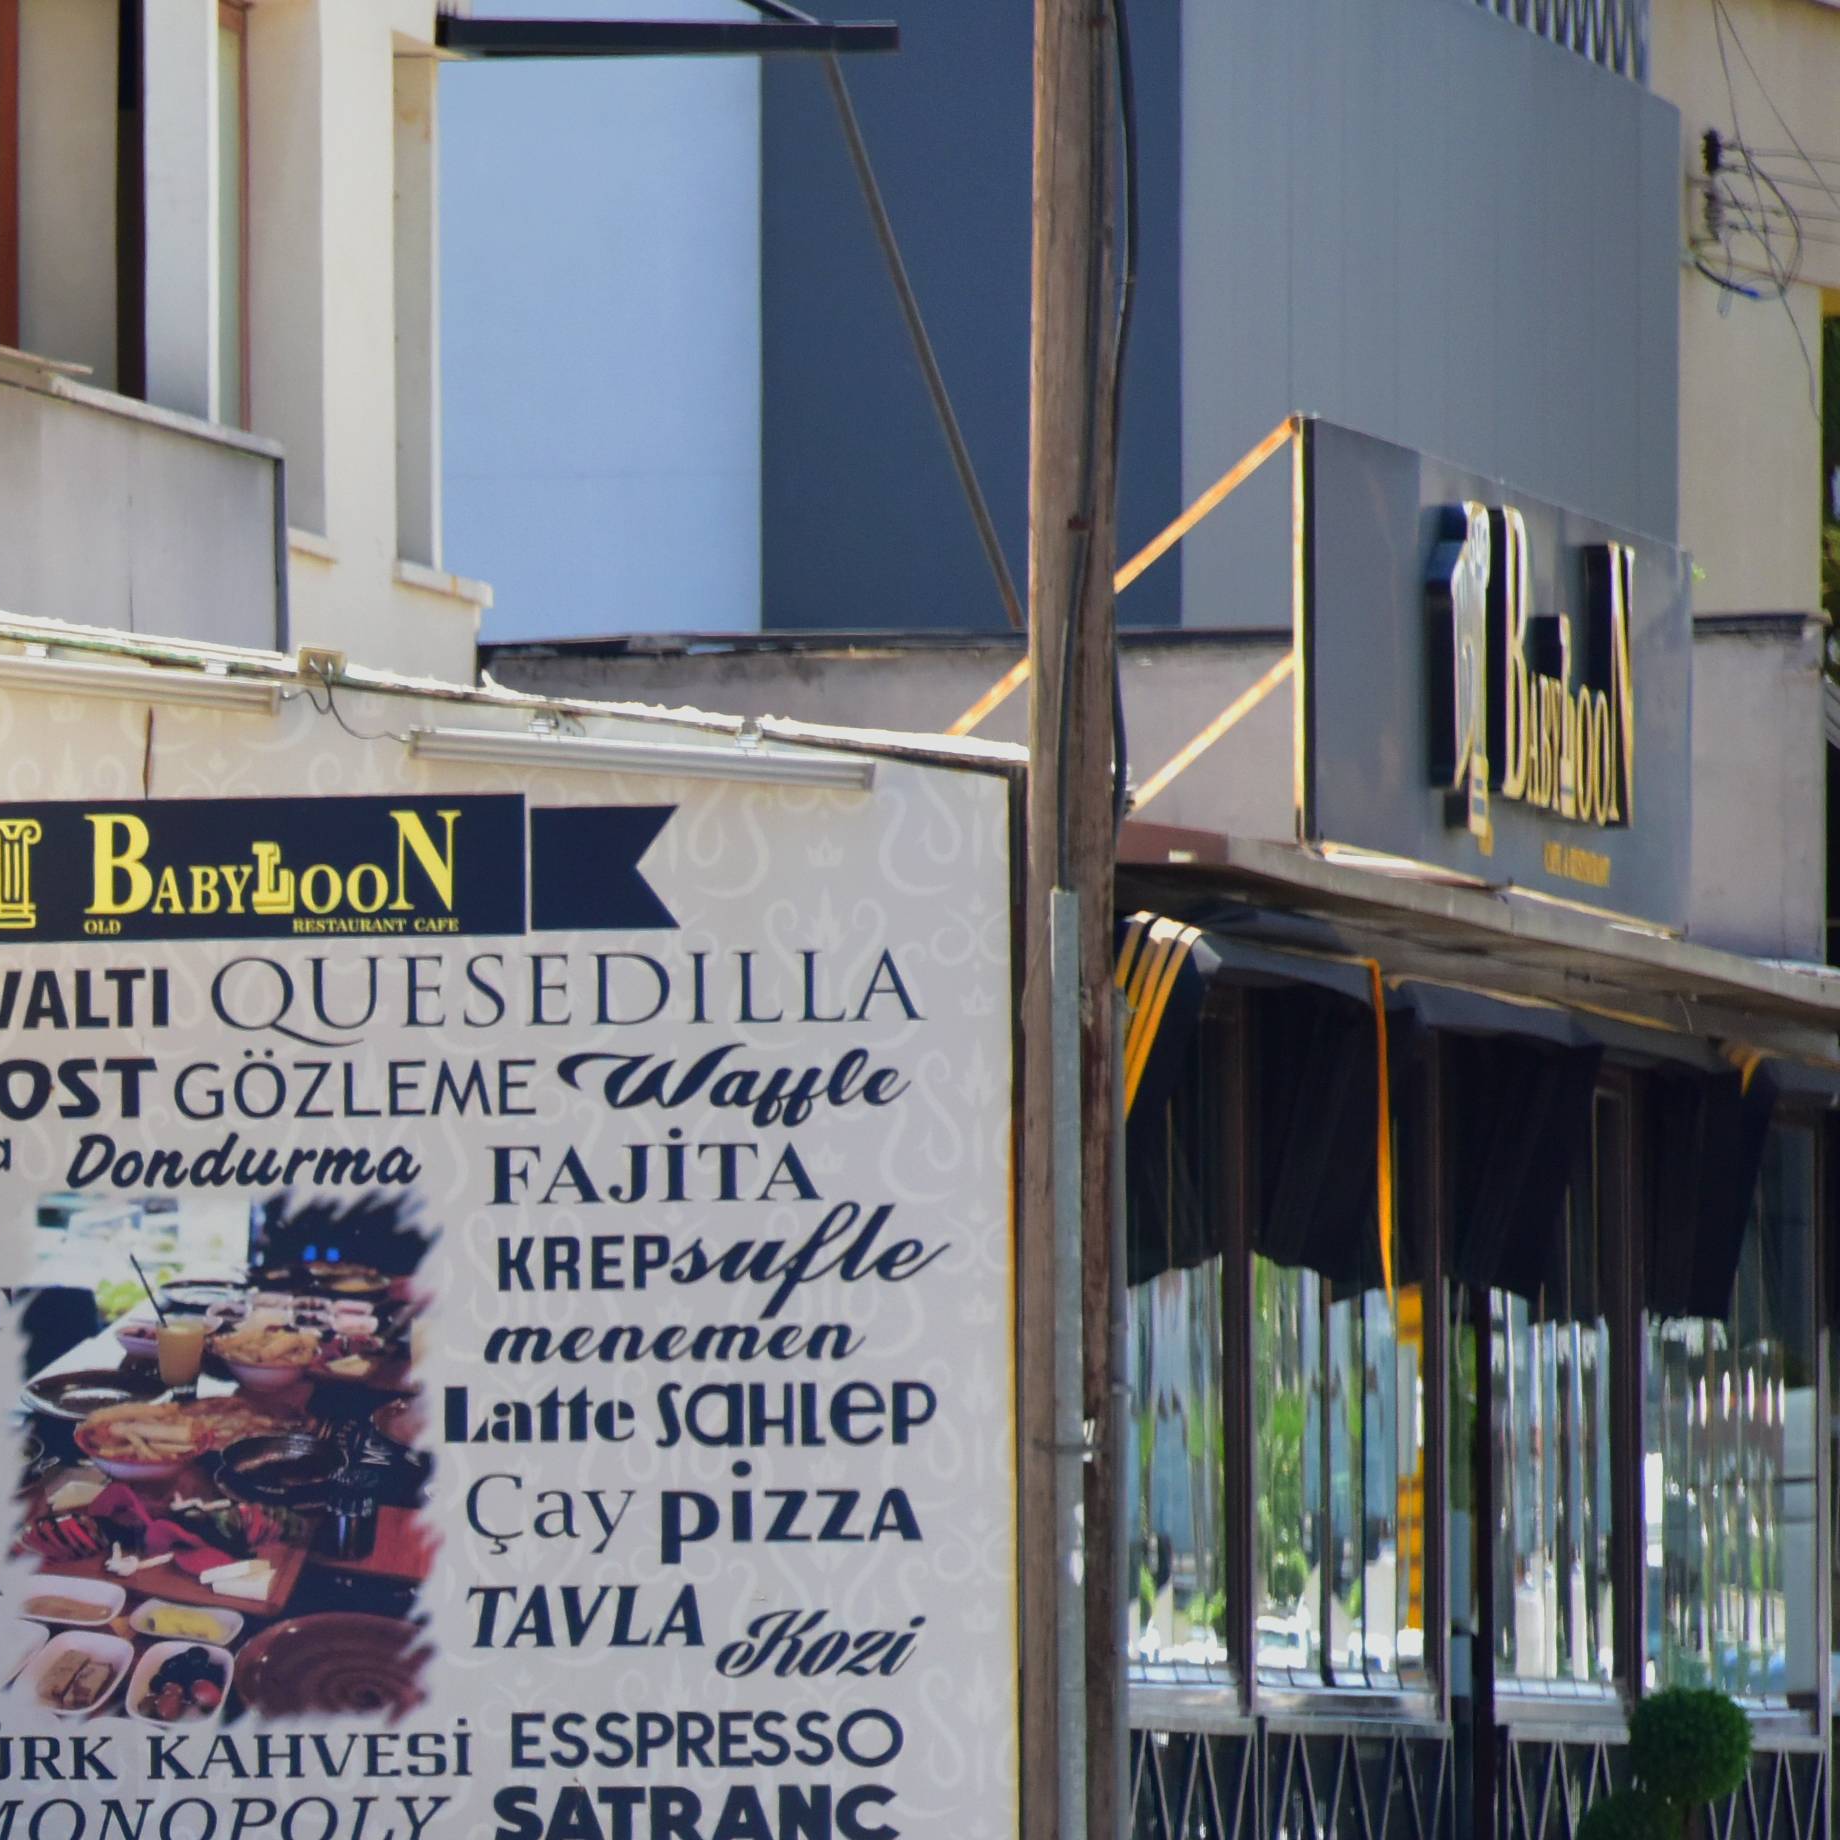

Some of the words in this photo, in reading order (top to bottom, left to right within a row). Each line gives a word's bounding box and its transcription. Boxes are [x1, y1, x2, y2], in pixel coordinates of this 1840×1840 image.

[84, 919, 121, 935] OLD
[292, 917, 407, 934] RESTAURANT
[414, 916, 460, 933] CAFE
[211, 948, 926, 1046] QUESEDILLA
[174, 1049, 537, 1121] GÖZLEME
[557, 1043, 912, 1129] Waffle
[66, 1133, 423, 1189] Dondurma
[486, 1127, 824, 1205] FAJİTA
[483, 1322, 867, 1365] menemen
[444, 1386, 635, 1443] Latte
[466, 1473, 636, 1555] Çay
[467, 1583, 706, 1650] TAVLA
[146, 1718, 473, 1780] KAHVESİ
[511, 1707, 905, 1769] ESSPRESSO
